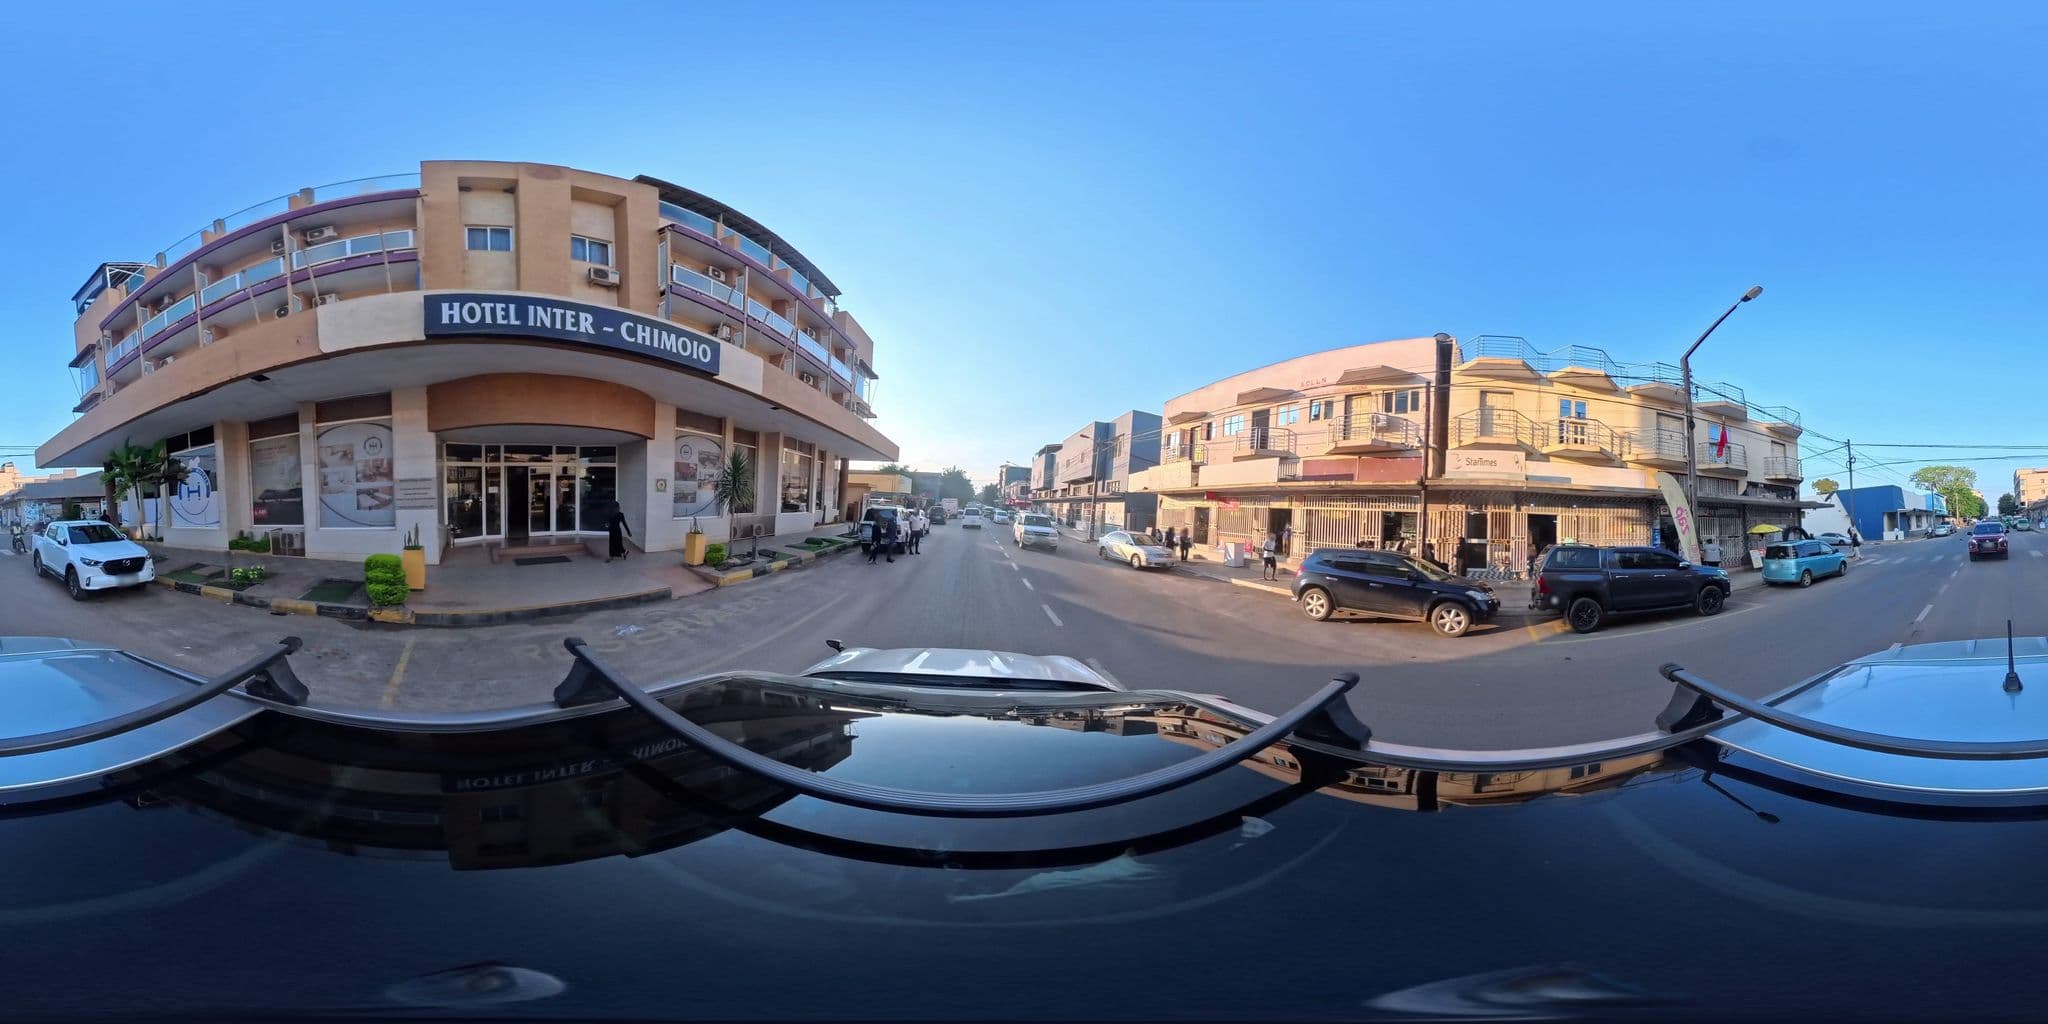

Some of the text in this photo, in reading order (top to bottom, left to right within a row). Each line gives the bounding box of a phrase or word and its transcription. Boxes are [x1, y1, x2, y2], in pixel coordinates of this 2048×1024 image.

[441, 302, 522, 325] HOTEL
[527, 305, 596, 335] INTER
[620, 321, 712, 363] CHIMOIO
[1465, 457, 1497, 467] StarTimes
